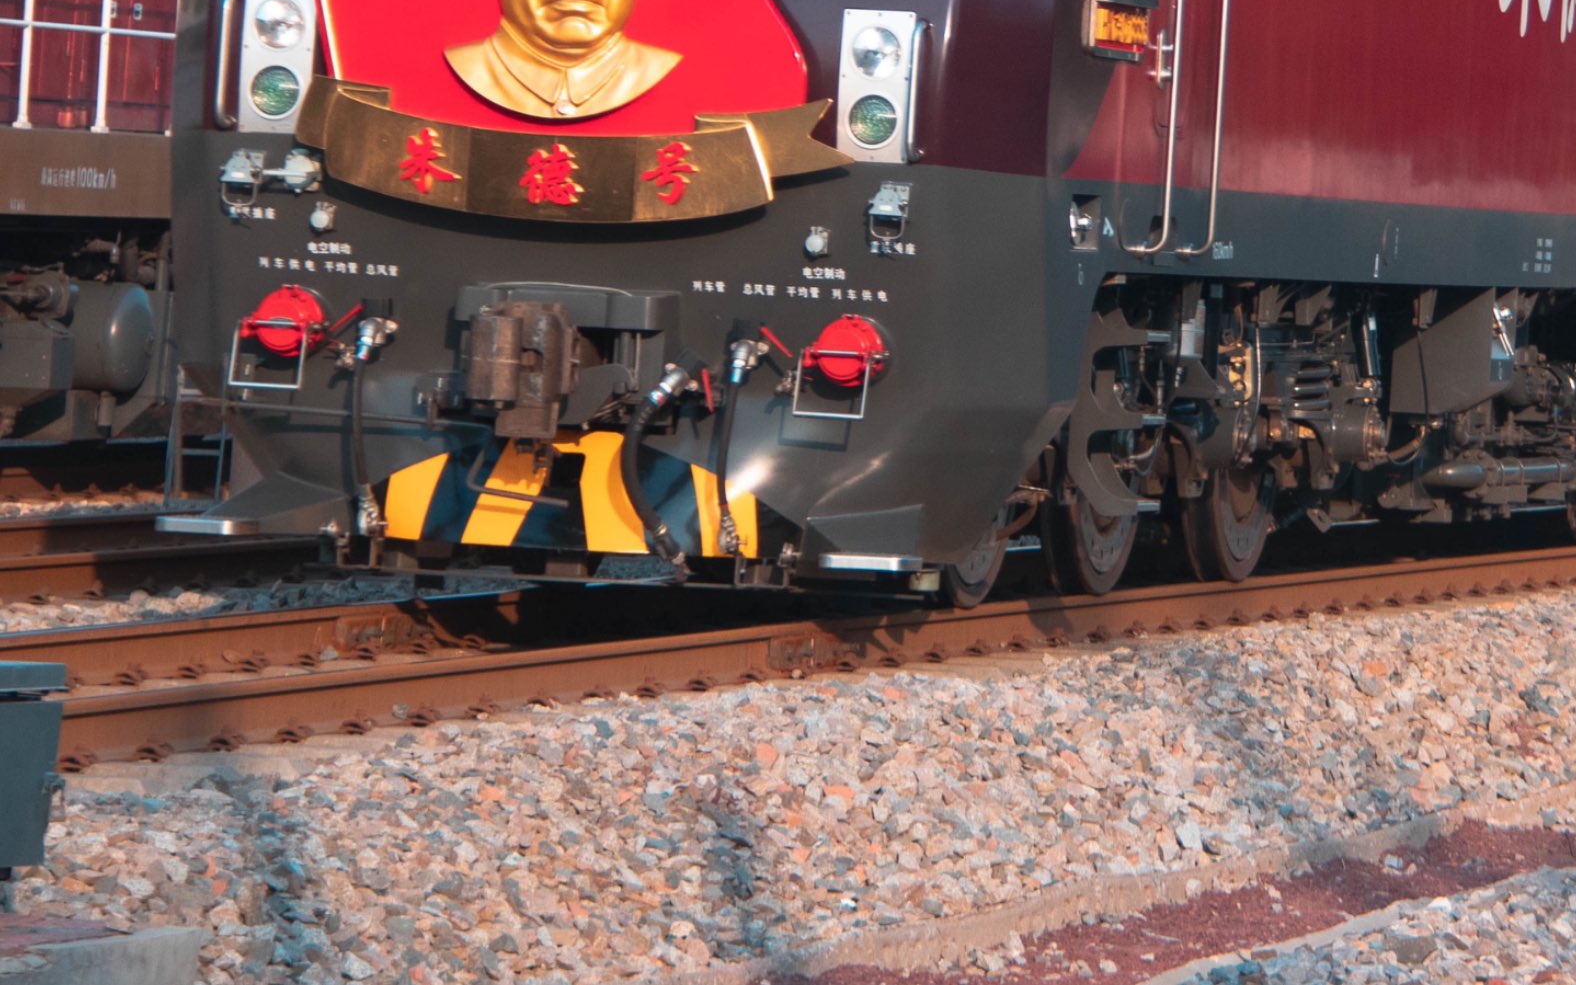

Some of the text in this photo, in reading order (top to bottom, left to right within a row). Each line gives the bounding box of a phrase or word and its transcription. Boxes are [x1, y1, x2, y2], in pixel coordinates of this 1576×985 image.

[400, 127, 699, 205] 朱德号
[307, 242, 352, 254] 电空制动
[802, 267, 846, 280] 电空制动
[742, 283, 776, 297] 总风管
